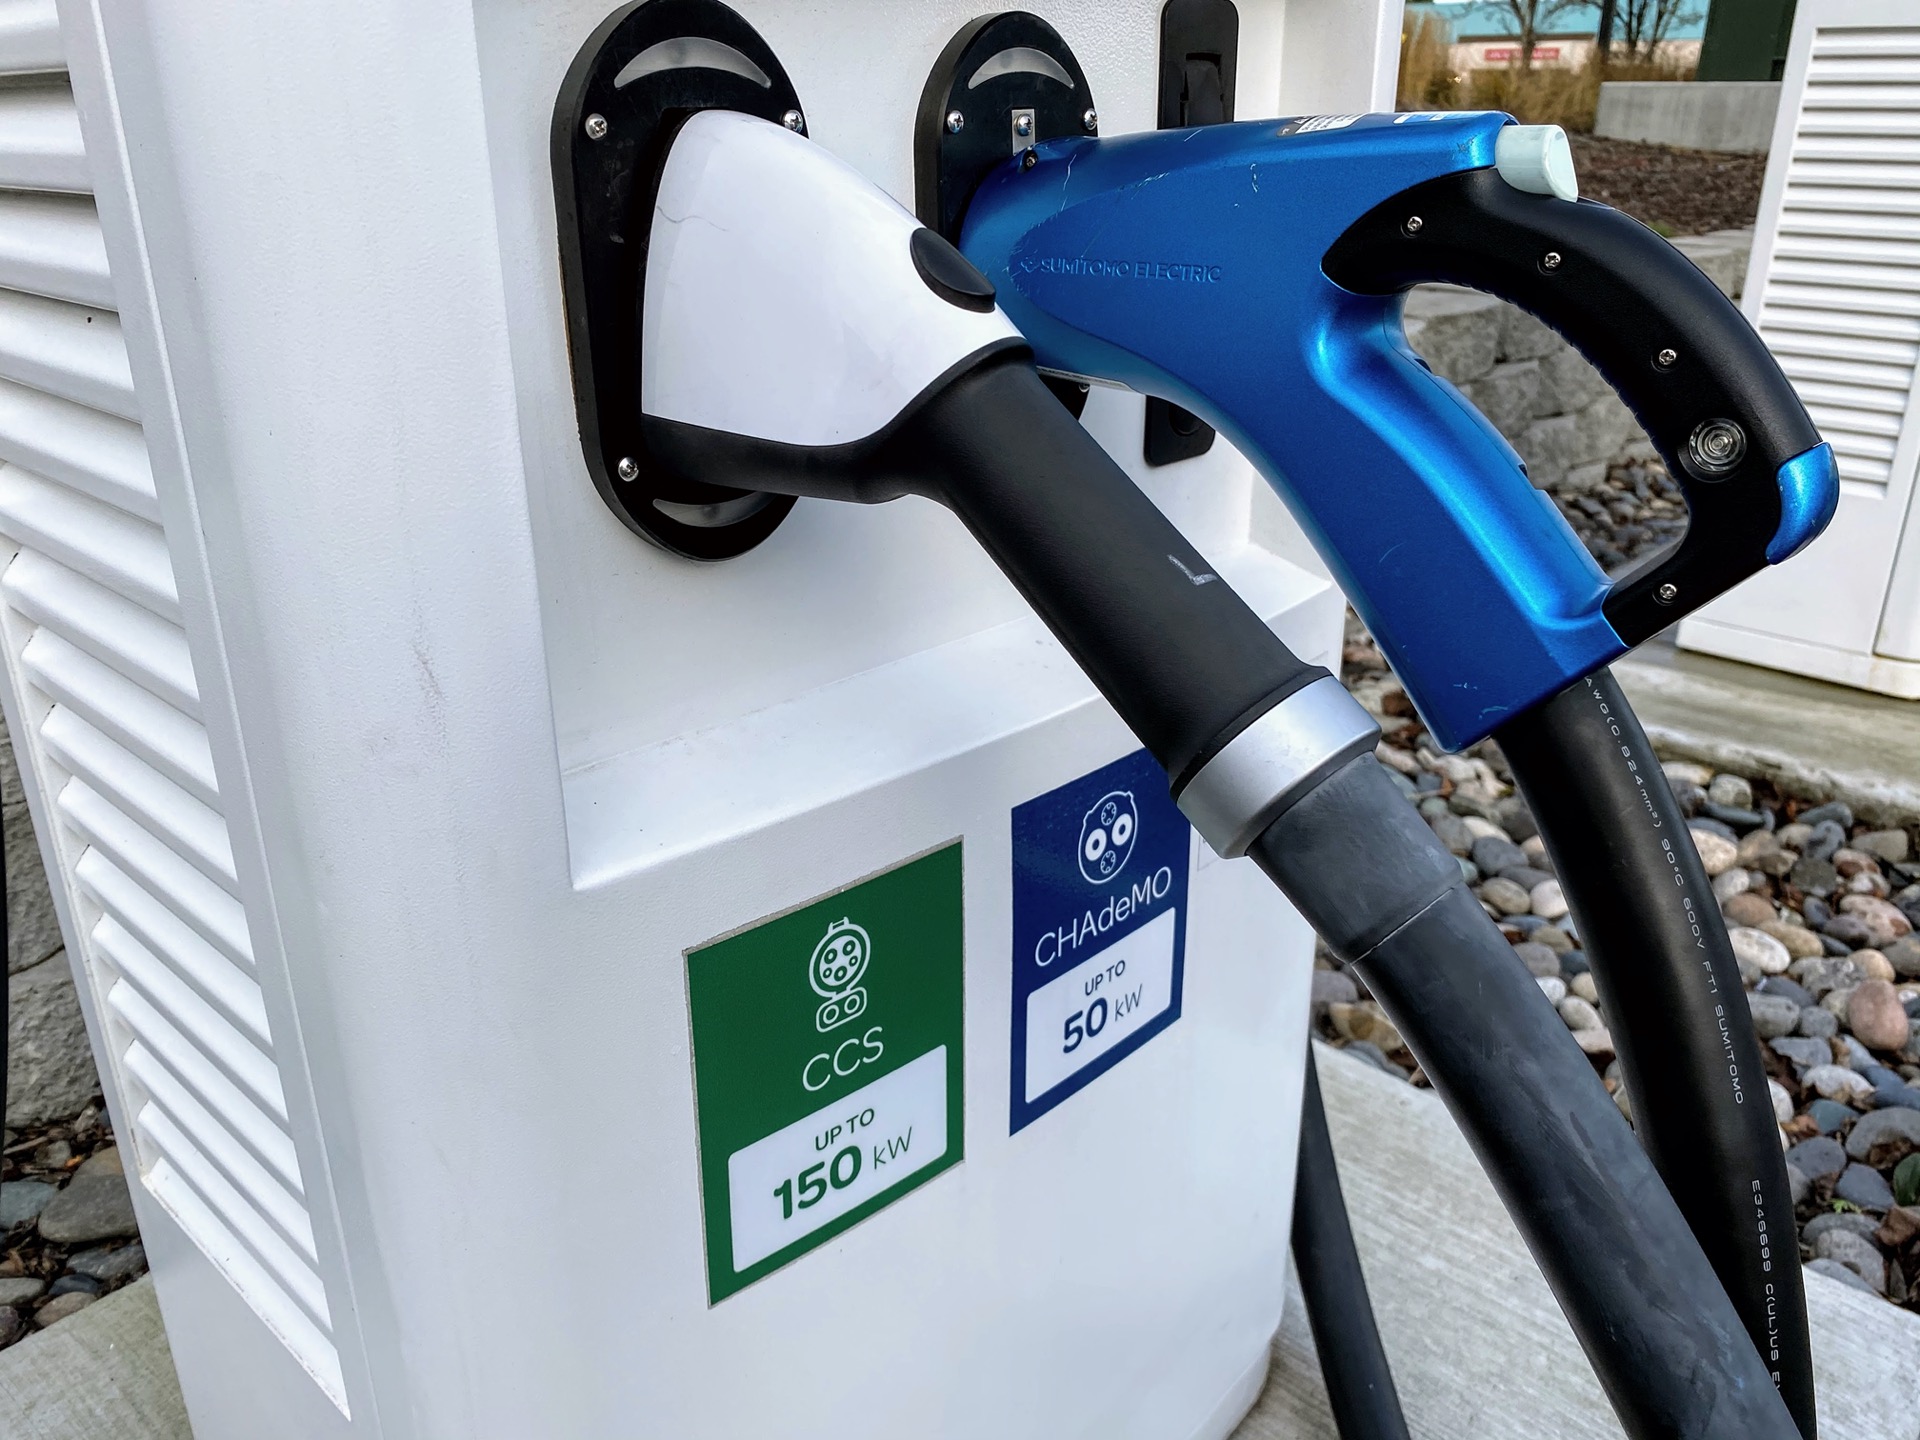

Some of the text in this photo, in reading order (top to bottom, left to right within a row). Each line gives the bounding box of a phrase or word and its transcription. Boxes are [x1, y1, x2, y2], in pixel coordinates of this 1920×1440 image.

[1041, 258, 1223, 283] SUMITOMO ELECTRIC
[1034, 866, 1171, 967] CHAdeMO
[1085, 959, 1126, 996] UP TO
[1683, 897, 1706, 950] 600V
[1715, 1004, 1744, 1105] SUMITOMO
[1062, 984, 1143, 1053] 50 kW
[802, 1027, 885, 1092] CCS
[815, 1108, 875, 1152] UP TO
[773, 1126, 914, 1220] 150 kW
[1751, 1179, 1772, 1272] E346699
